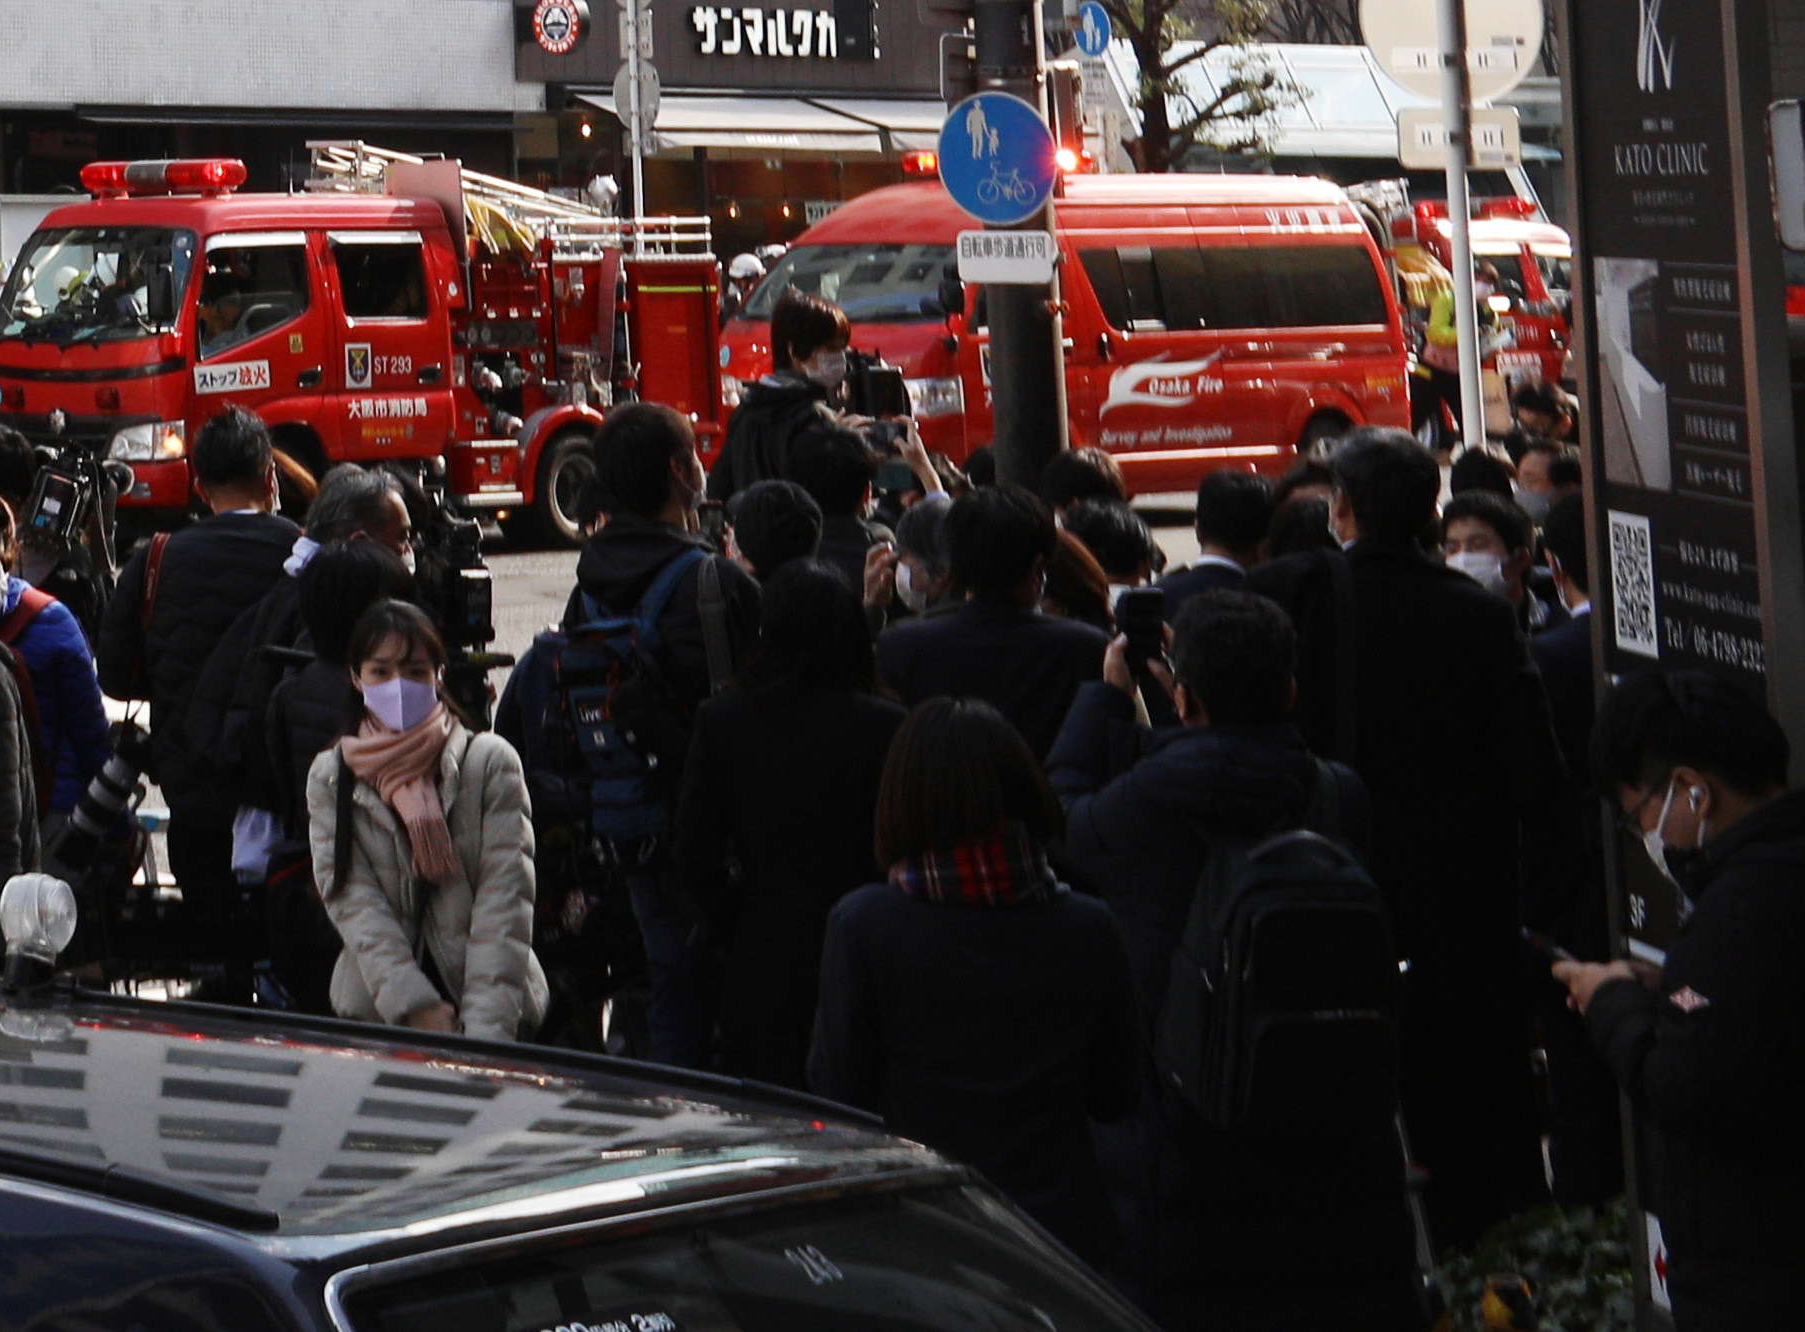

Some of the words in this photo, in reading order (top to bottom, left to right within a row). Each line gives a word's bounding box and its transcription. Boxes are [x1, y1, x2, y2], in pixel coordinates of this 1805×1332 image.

[1614, 143, 1653, 176] KATO
[1656, 141, 1709, 176] CLINIC
[960, 235, 1047, 261] 自転車歩道通行可
[374, 355, 390, 374] ST
[391, 355, 413, 374] 293
[197, 366, 268, 389] ストップ放火
[1148, 375, 1190, 396] Osaka
[1196, 375, 1225, 396] Fire
[348, 397, 428, 421] 大阪市消防局
